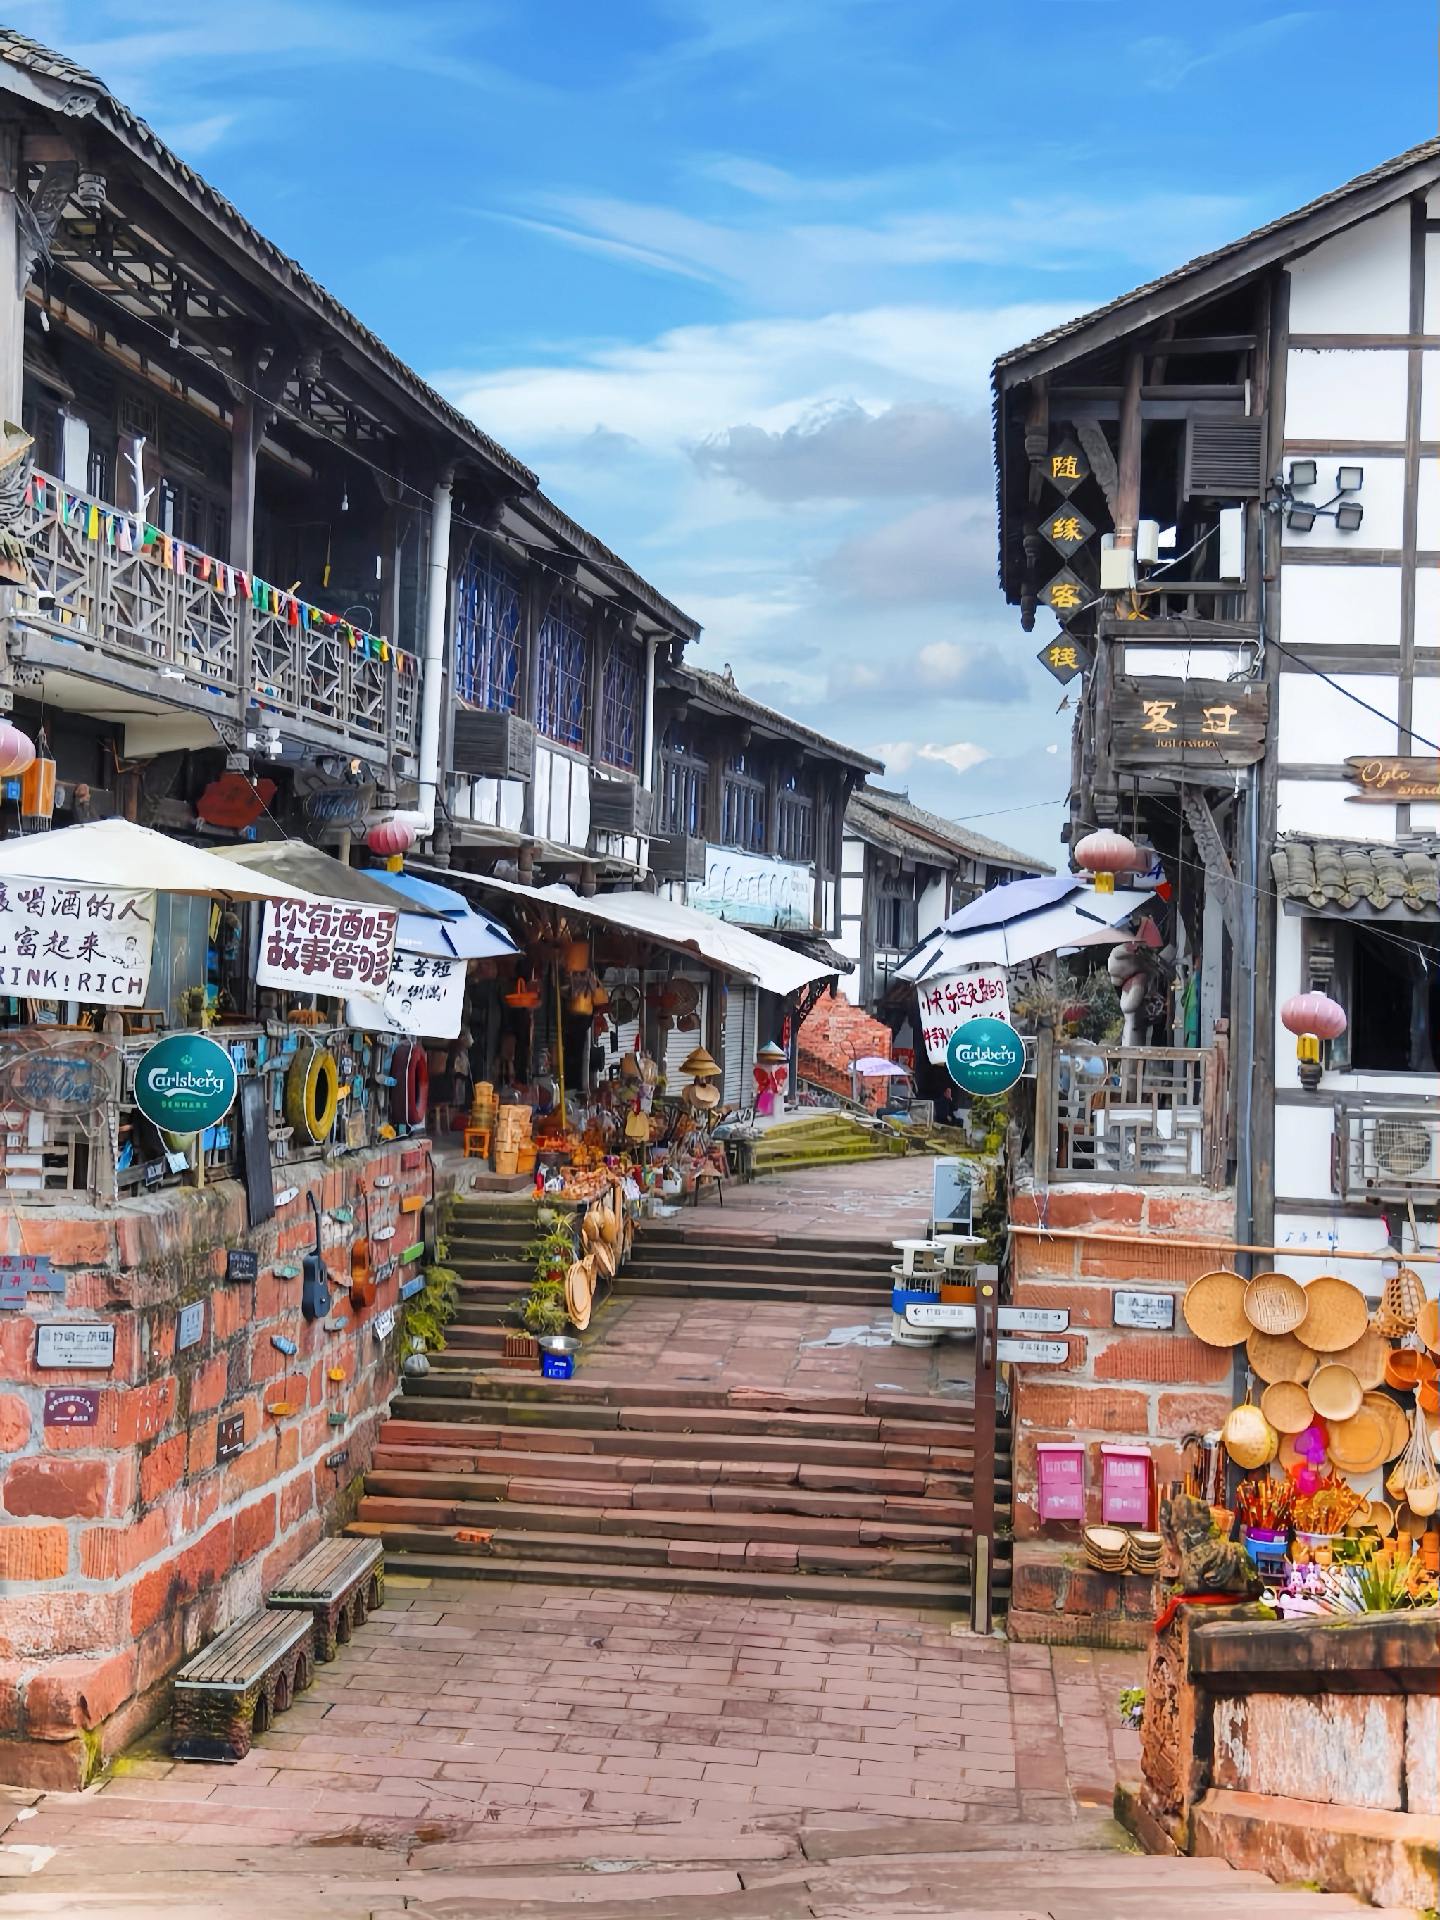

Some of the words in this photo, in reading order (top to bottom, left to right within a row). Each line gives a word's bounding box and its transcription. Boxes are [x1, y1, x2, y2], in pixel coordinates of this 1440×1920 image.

[1051, 456, 1084, 669] 随缘客栈
[0, 926, 107, 964] 富起来
[271, 899, 397, 948] 你有酒吗
[266, 929, 391, 986] 故事管够
[955, 1044, 1016, 1067] Carlsberg
[147, 1067, 225, 1097] Carlsberg
